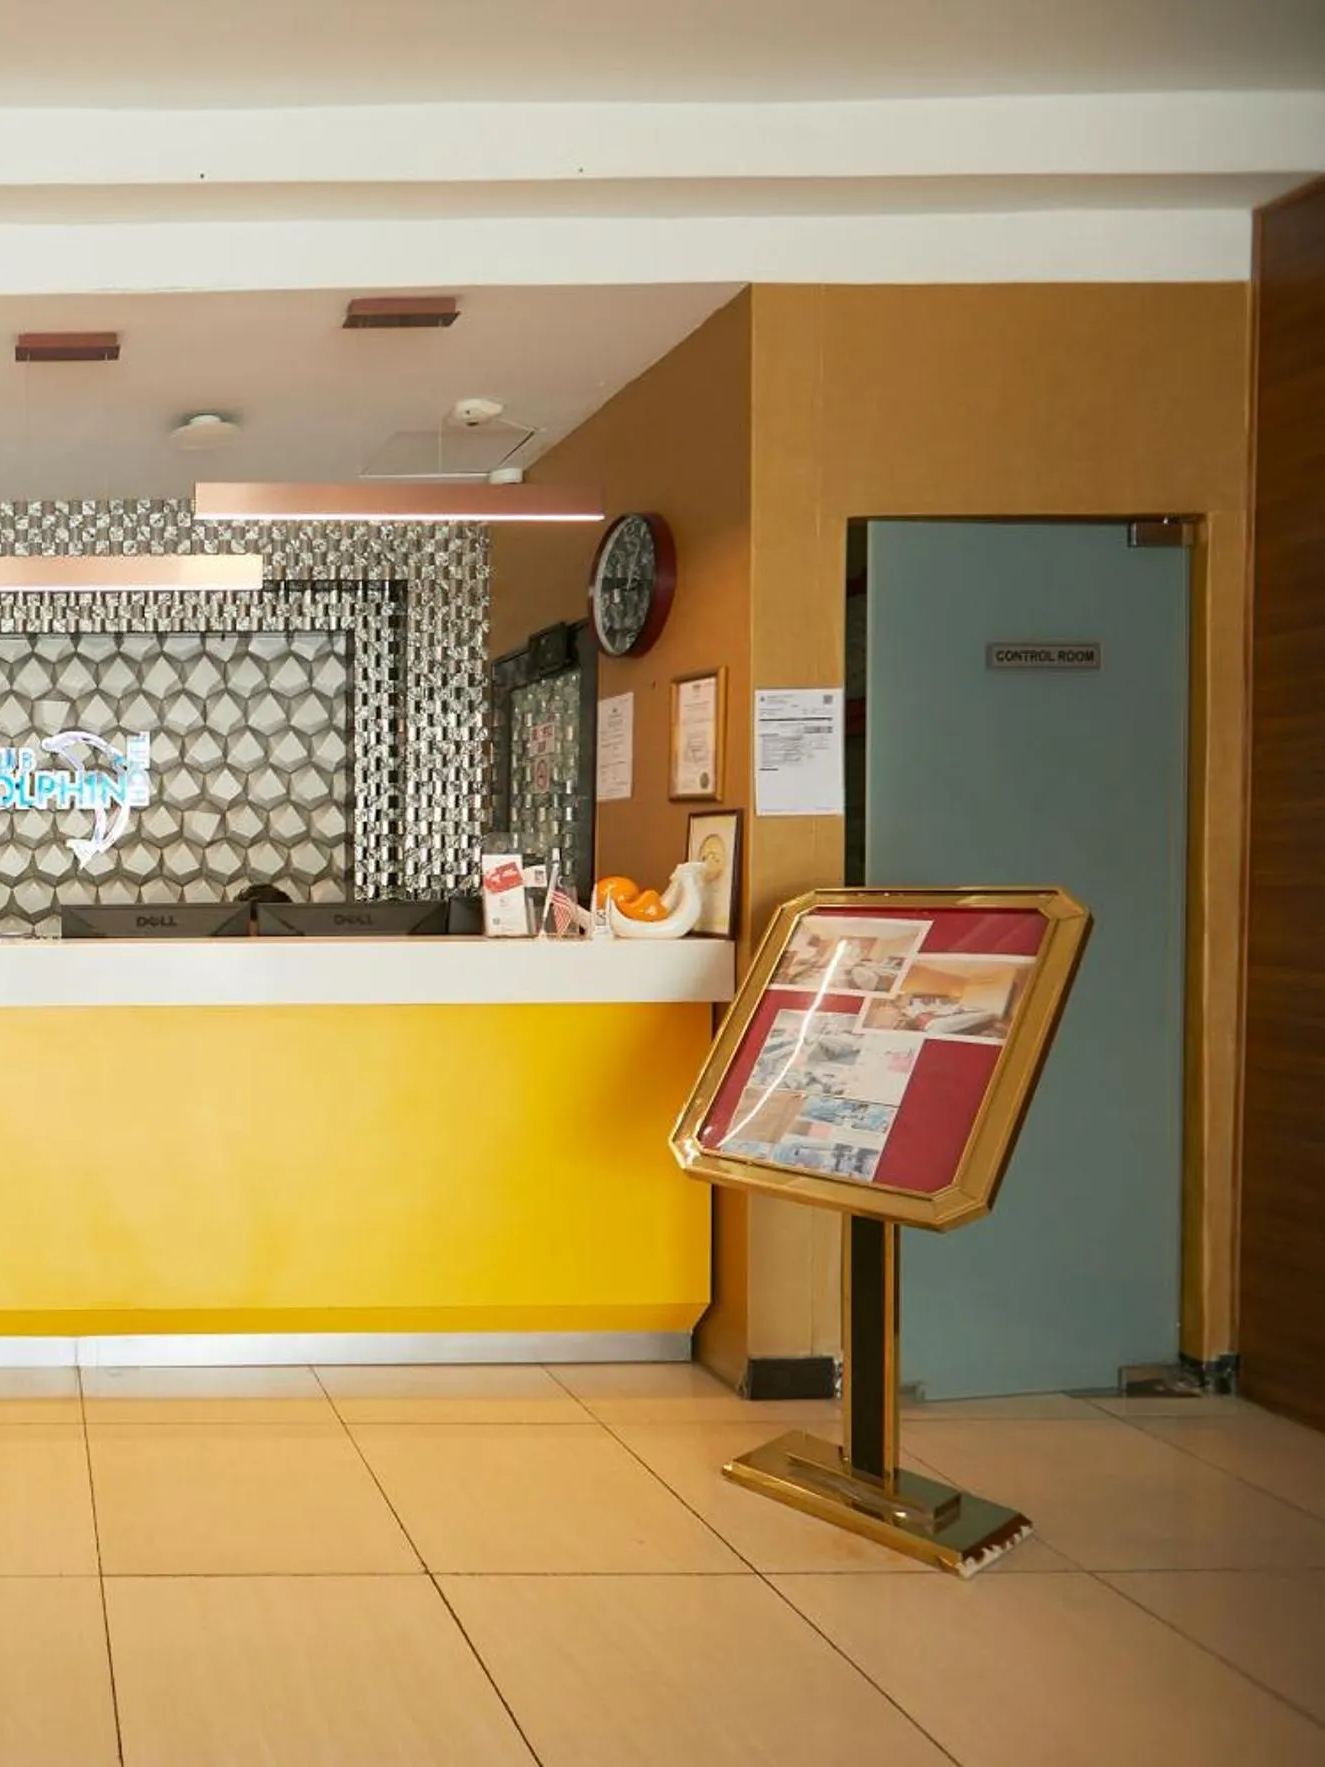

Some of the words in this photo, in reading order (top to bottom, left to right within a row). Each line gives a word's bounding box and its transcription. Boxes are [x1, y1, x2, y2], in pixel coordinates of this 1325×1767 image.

[995, 650, 1055, 662] CONTROL
[1057, 649, 1094, 662] ROOM
[136, 914, 177, 928] DELL
[333, 912, 375, 927] DELL
